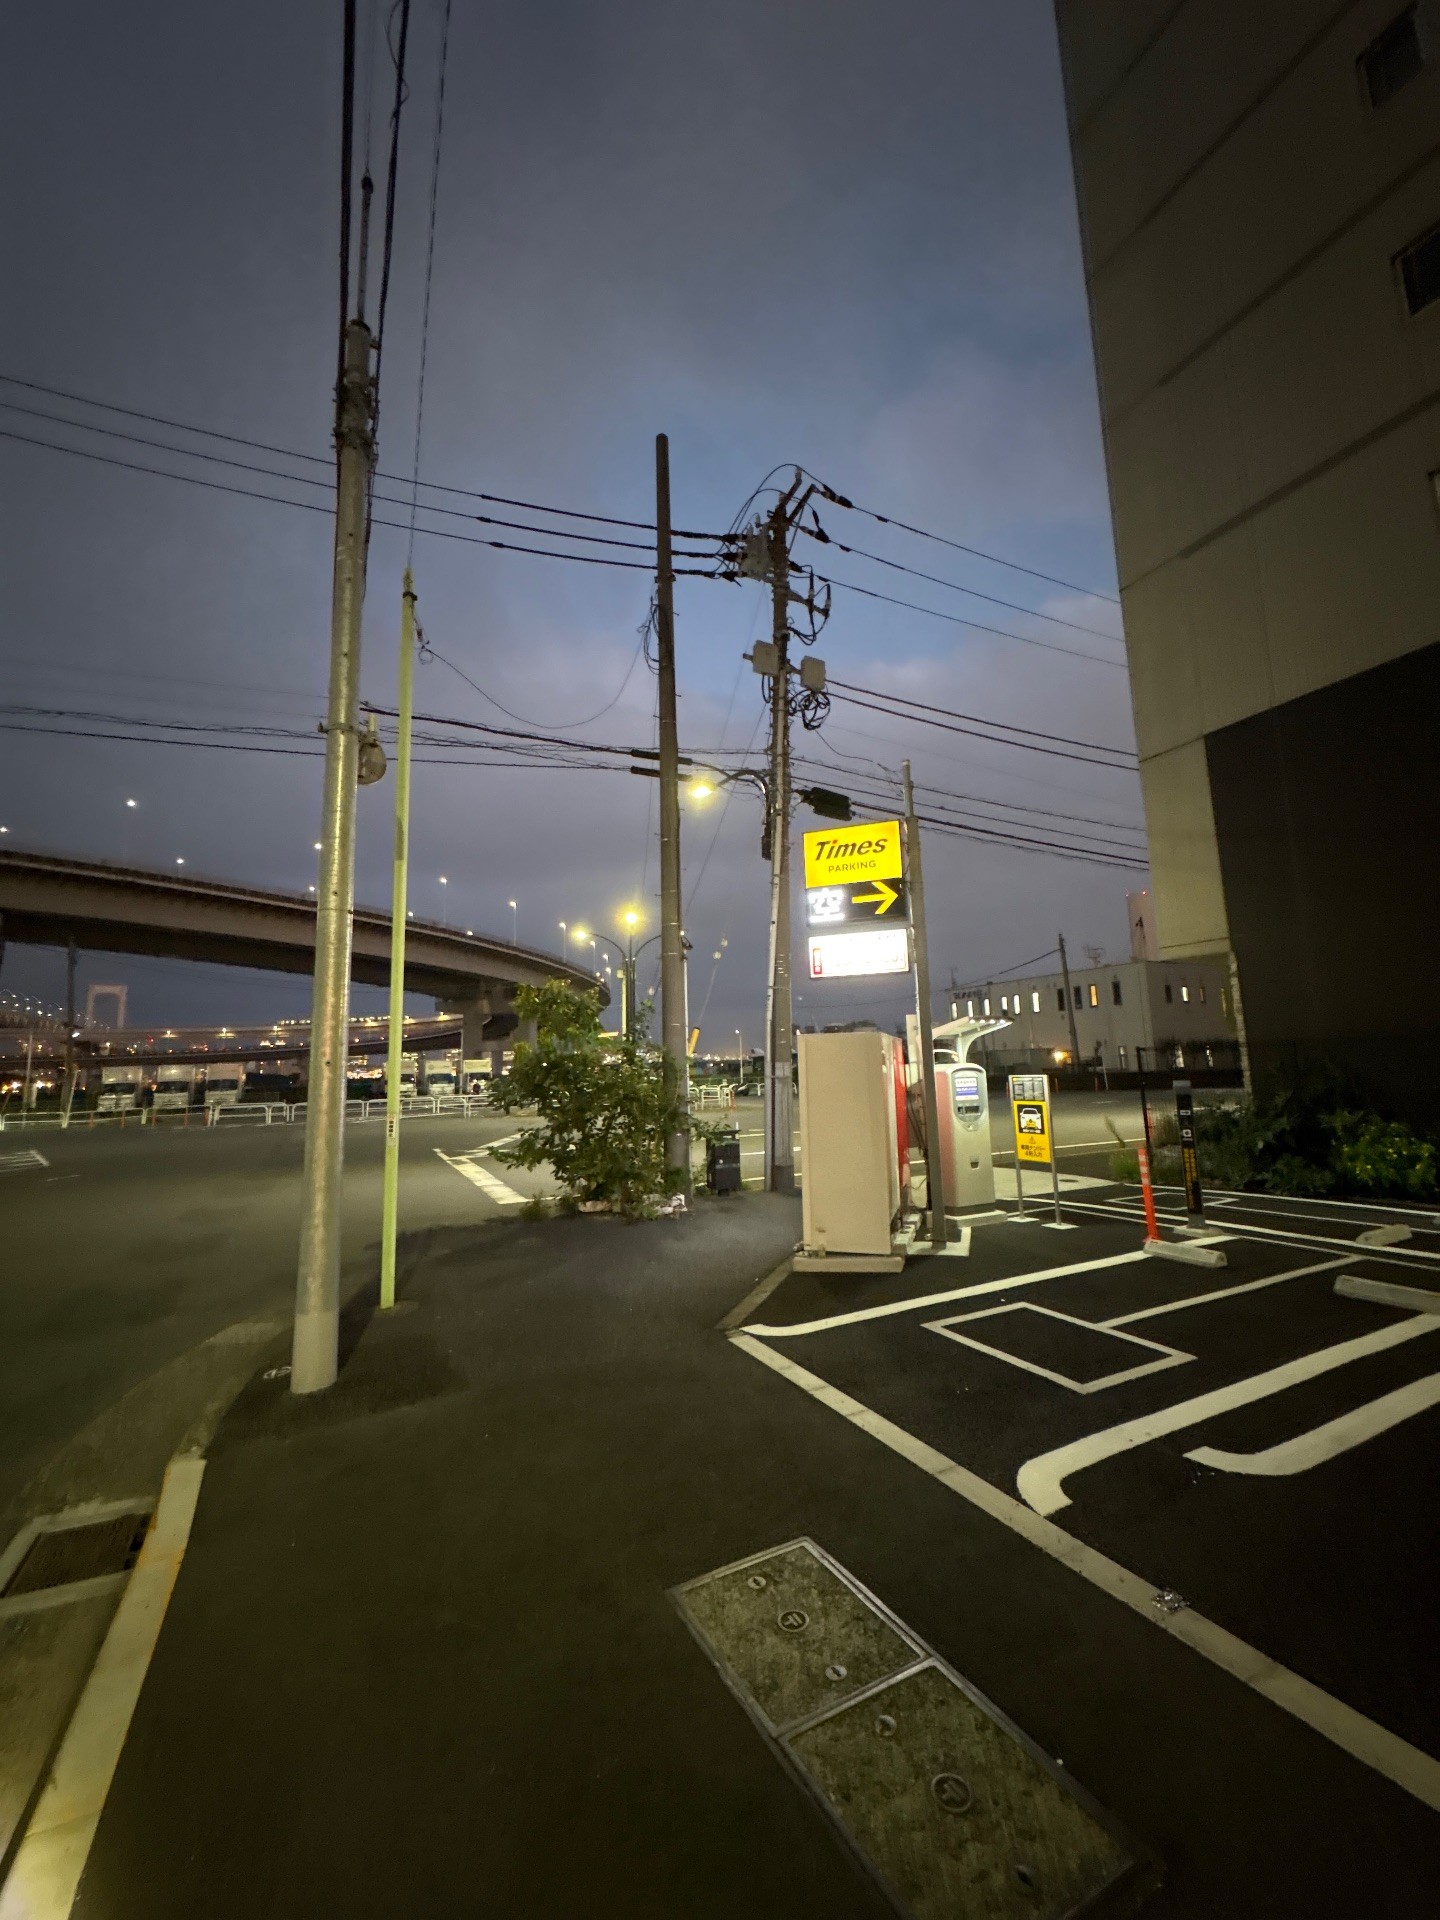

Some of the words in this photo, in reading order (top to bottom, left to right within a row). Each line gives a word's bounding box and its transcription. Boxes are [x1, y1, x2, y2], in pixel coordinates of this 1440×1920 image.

[815, 838, 888, 861] Times
[828, 860, 876, 873] PARKING
[808, 887, 845, 923] 空
